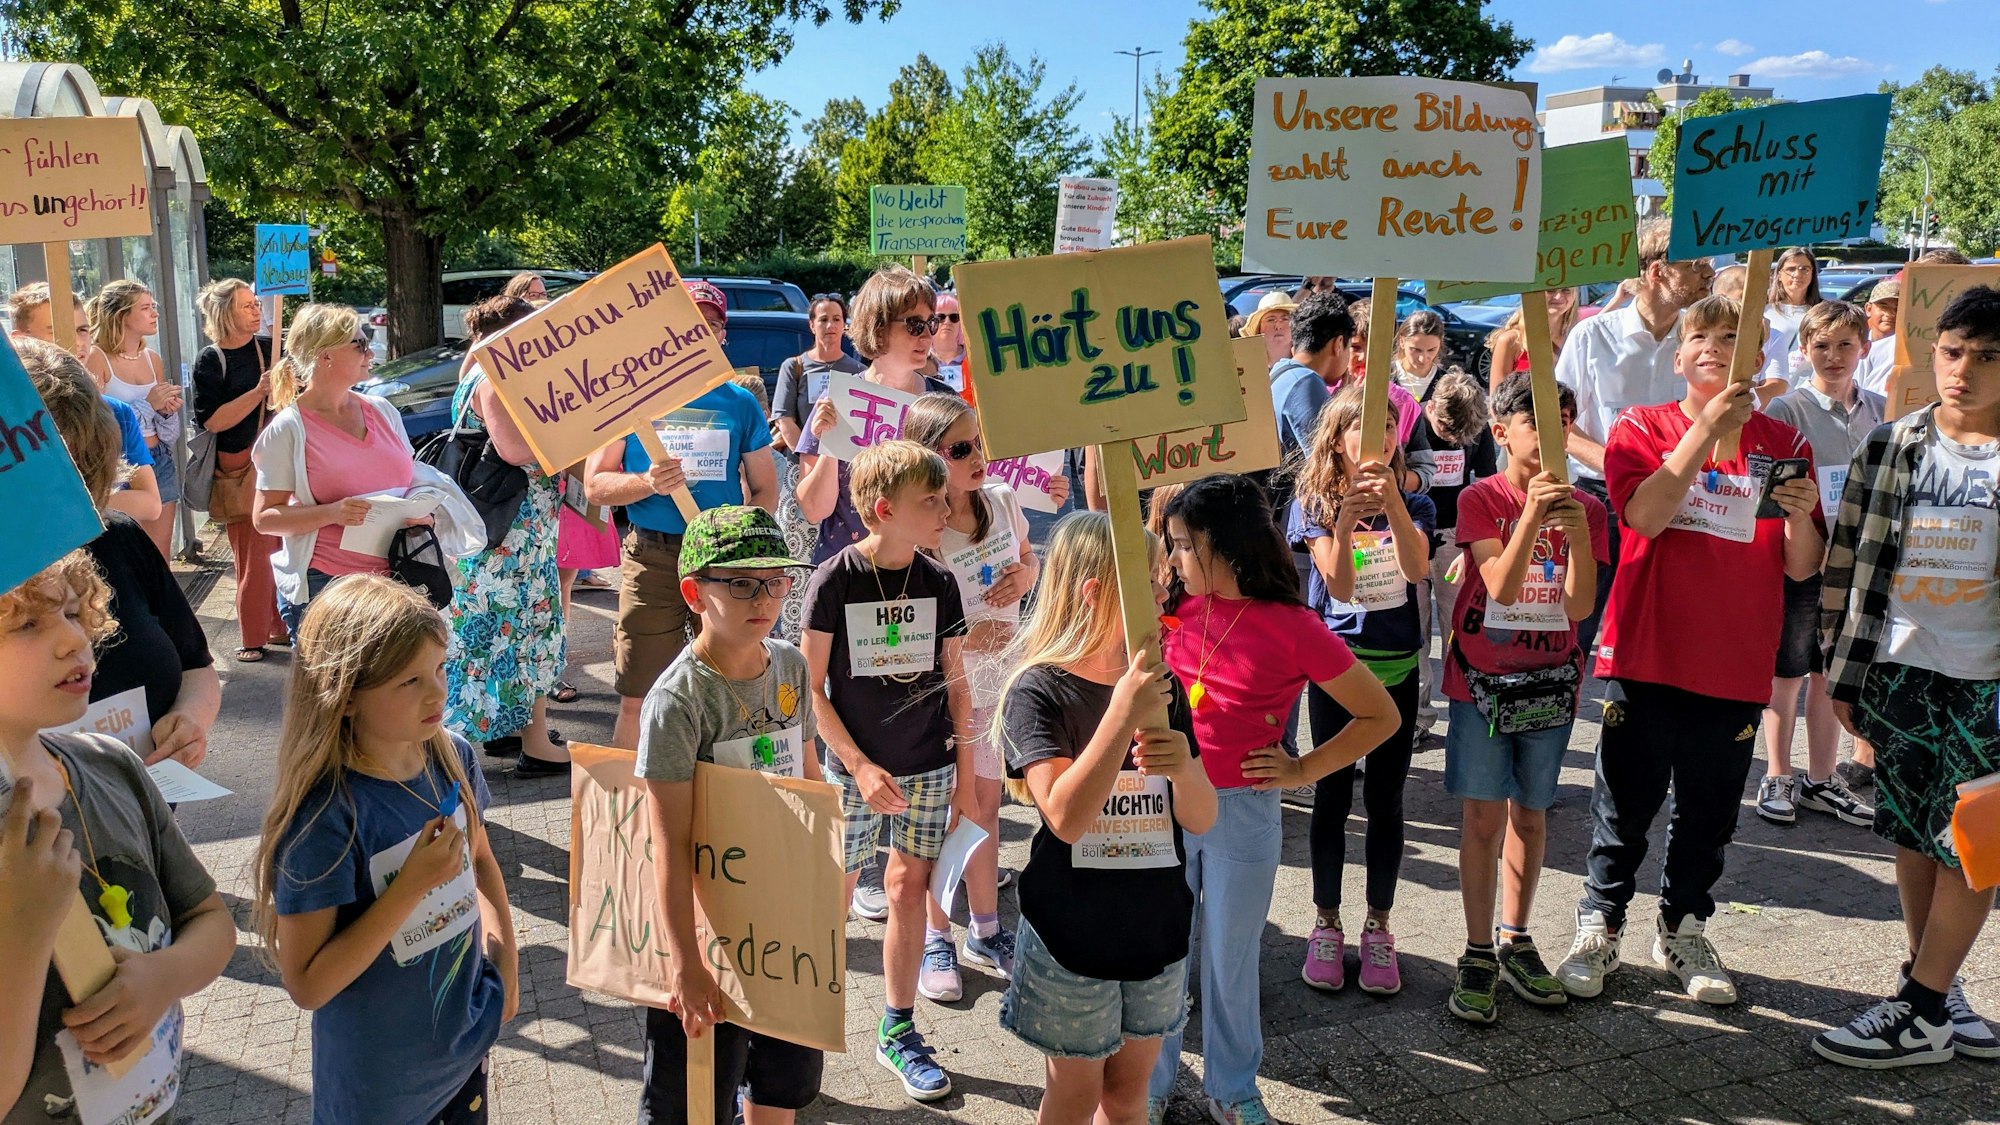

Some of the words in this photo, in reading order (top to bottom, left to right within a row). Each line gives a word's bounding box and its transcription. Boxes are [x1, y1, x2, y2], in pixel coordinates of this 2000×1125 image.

[1273, 89, 1398, 132] Unsere
[1414, 92, 1537, 151] Bildung
[24, 138, 100, 176] fühlen
[1686, 120, 1818, 175] Schluss
[1268, 147, 1350, 181] zahlt
[1382, 149, 1482, 178] auch
[1065, 183, 1090, 191] Neubau
[1757, 163, 1816, 197] mit
[34, 184, 147, 227] ungehört!
[874, 189, 895, 207] Wo
[899, 188, 948, 211] bleibt
[876, 213, 894, 228] die
[1266, 206, 1348, 240] Eure
[1377, 192, 1498, 238] Rente
[1539, 203, 1628, 234] rzigen
[1692, 200, 1869, 247] Verzögerung!
[877, 232, 966, 253] Transparenz?
[1077, 226, 1102, 234] Bildung
[487, 302, 623, 380] Neubau
[978, 287, 1103, 376] Hört
[1116, 300, 1201, 351] uns
[1080, 361, 1160, 405] zu
[524, 381, 582, 424] Wie
[697, 456, 724, 468] KÖPFE
[1131, 424, 1236, 480] Wort
[1434, 454, 1464, 462] UNSERE
[1948, 515, 1983, 533] FÜR
[952, 550, 975, 564] BILDUNG
[976, 538, 1000, 554] BRAUCHT
[964, 559, 974, 568] ALS
[975, 551, 992, 562] GUTEN
[992, 542, 1010, 556] WILLEN
[1904, 536, 1978, 551] BILDUNG!
[1382, 570, 1399, 578] EINEN
[876, 605, 915, 626] HBG
[856, 638, 868, 646] WO
[871, 636, 902, 646] LERNN
[752, 738, 790, 759] RUM
[750, 759, 764, 770] FÜR
[1117, 777, 1145, 792] GELD
[608, 787, 746, 884] Kne
[404, 926, 430, 946] Böll
[590, 885, 842, 994] Aueden!
